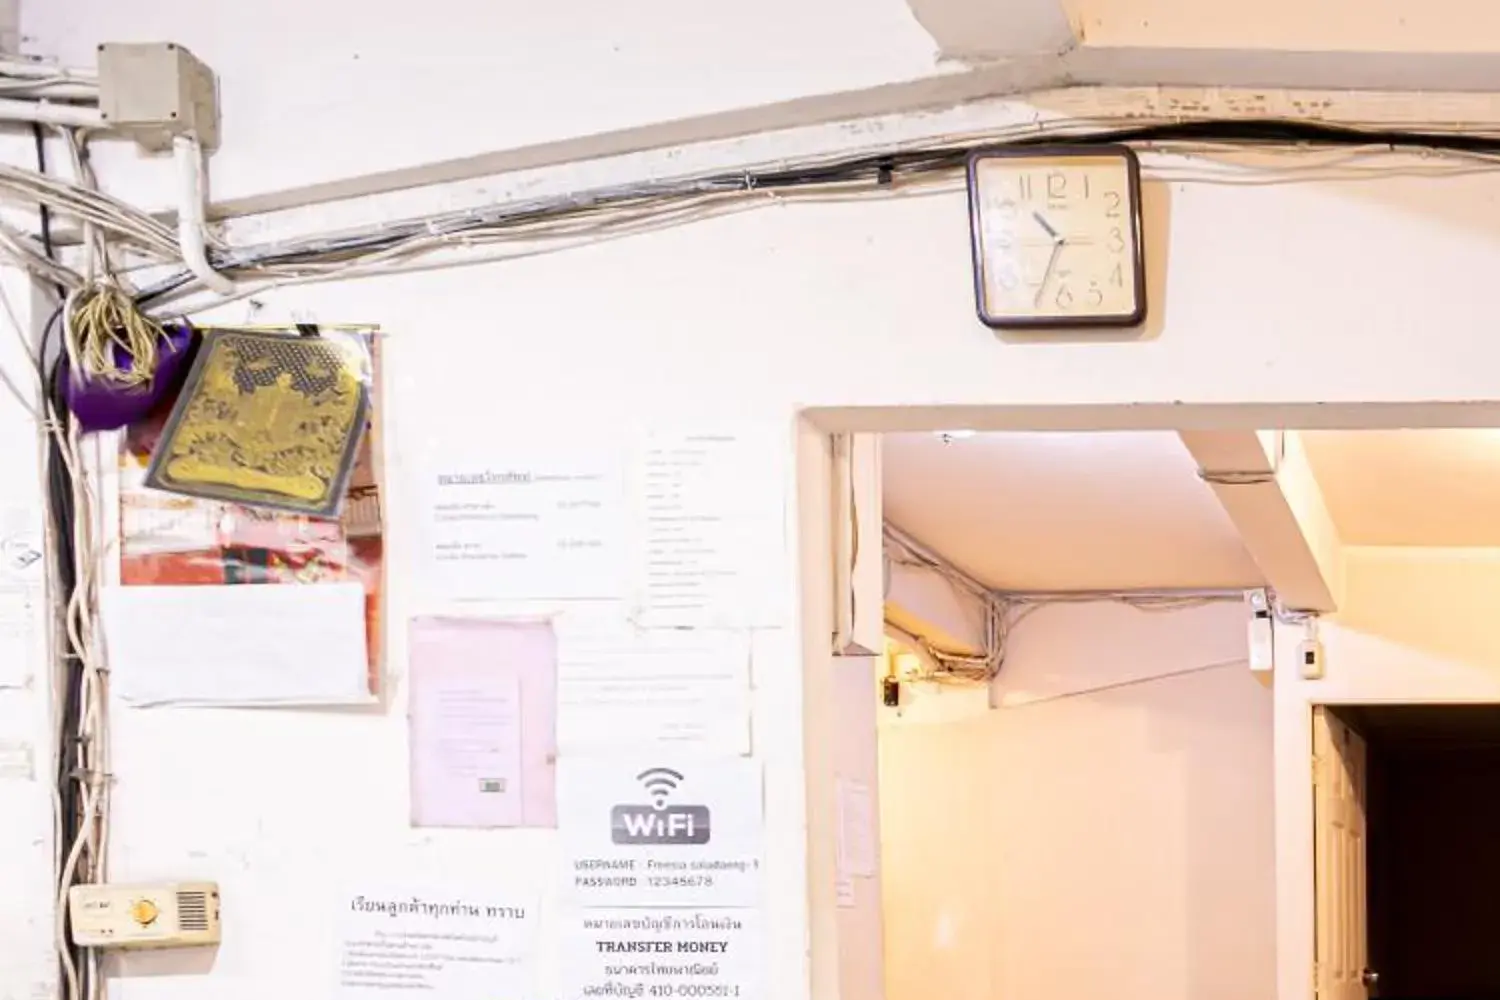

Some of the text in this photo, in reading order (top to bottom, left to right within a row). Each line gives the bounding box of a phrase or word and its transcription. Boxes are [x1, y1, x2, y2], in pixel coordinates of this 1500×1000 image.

[622, 813, 695, 837] WiFi
[574, 859, 637, 871] USERNAME
[574, 875, 714, 888] PASSWORD 12345678
[596, 941, 729, 953] TRANSFER MONEY
